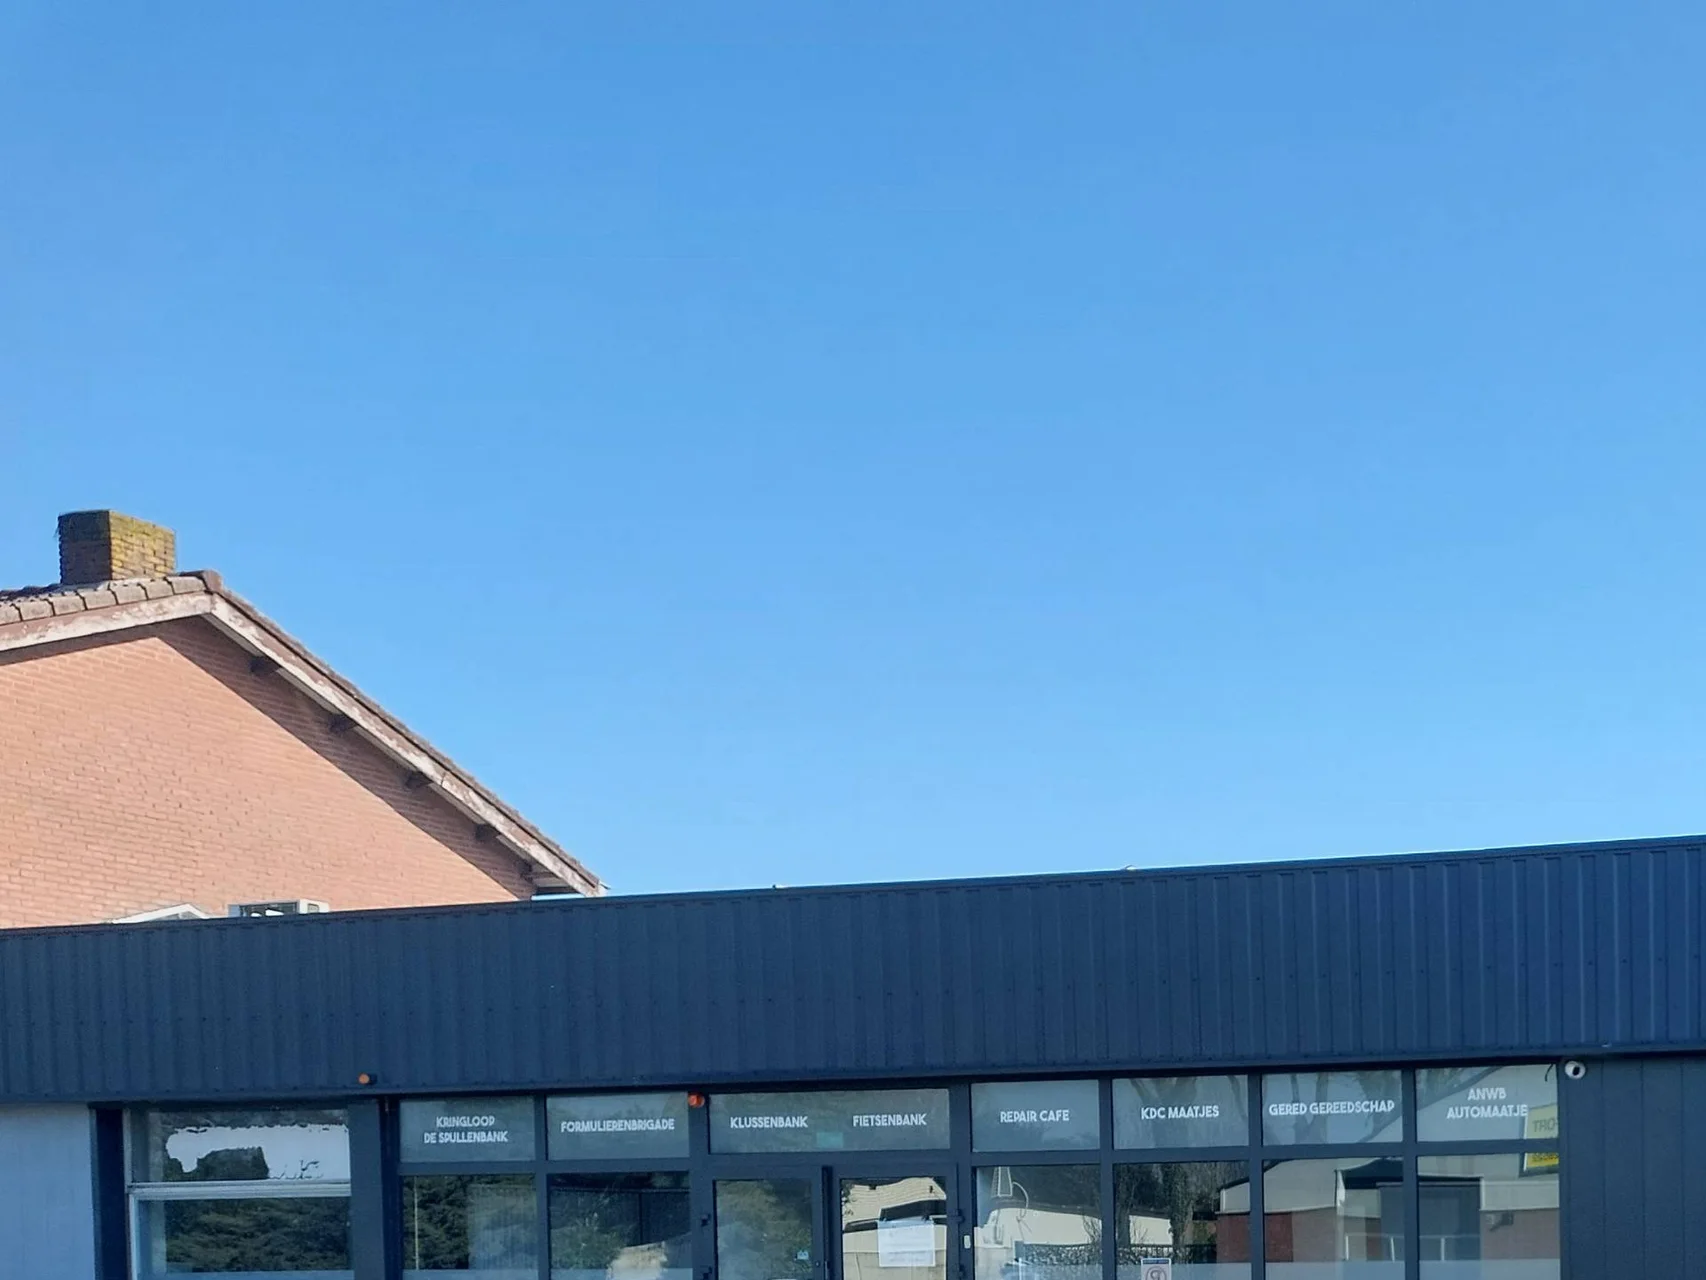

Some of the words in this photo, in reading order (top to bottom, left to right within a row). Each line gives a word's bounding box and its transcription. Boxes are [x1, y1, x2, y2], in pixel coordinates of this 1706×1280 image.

[1467, 1087, 1507, 1101] ANWB
[1141, 1107, 1166, 1120] KDC
[1168, 1105, 1220, 1119] MAATJES
[1269, 1102, 1307, 1116] GERED
[1309, 1100, 1395, 1115] GEREEDSCHAP
[1446, 1104, 1528, 1120] AUTOMAATJE
[436, 1115, 495, 1128] KRINGLOOP
[730, 1116, 808, 1129] KLUSSENBANK
[853, 1113, 927, 1127] FIETSENBANK
[1000, 1111, 1037, 1123] REPAIR
[1039, 1109, 1070, 1122] CAFE
[560, 1118, 675, 1133] FORMULIERENBRIGADE
[424, 1132, 437, 1144] DE
[438, 1130, 508, 1143] SPULLENBANK
